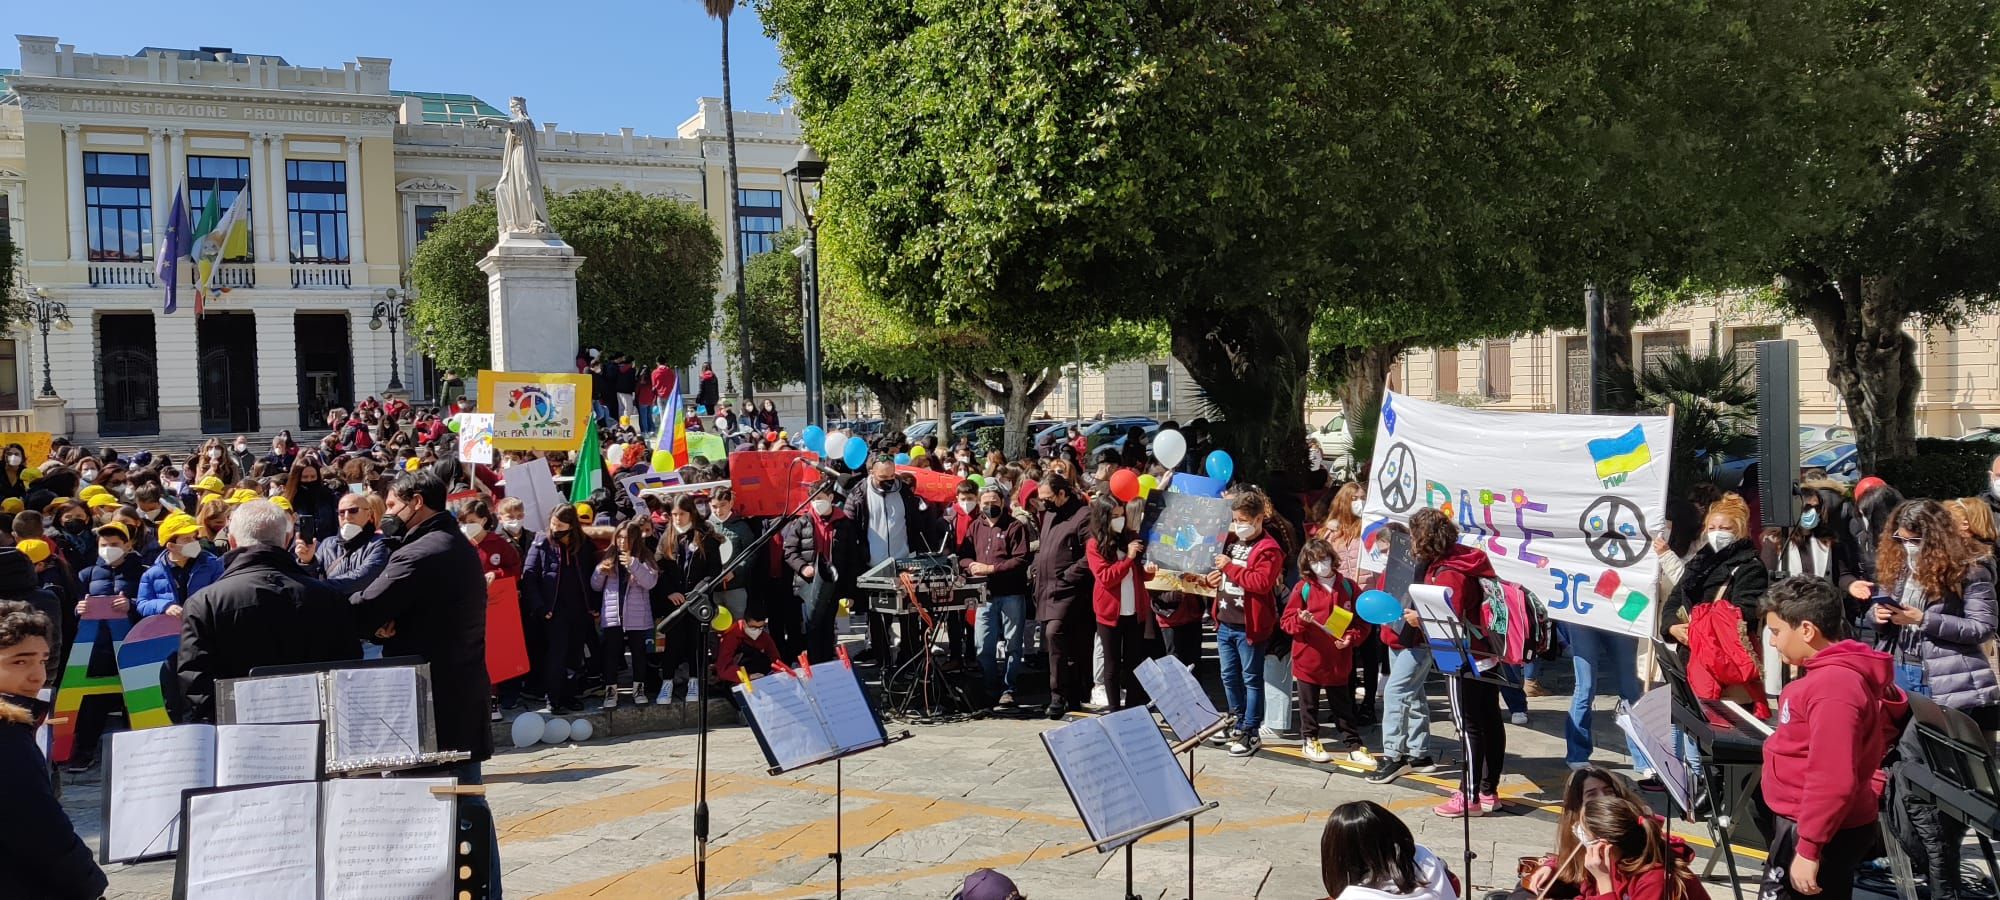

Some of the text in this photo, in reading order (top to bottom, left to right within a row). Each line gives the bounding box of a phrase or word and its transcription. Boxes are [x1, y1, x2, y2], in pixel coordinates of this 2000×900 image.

[71, 99, 352, 124] AMMINISTRAZIONE PROVINCIALE
[1425, 479, 1554, 569] PACE
